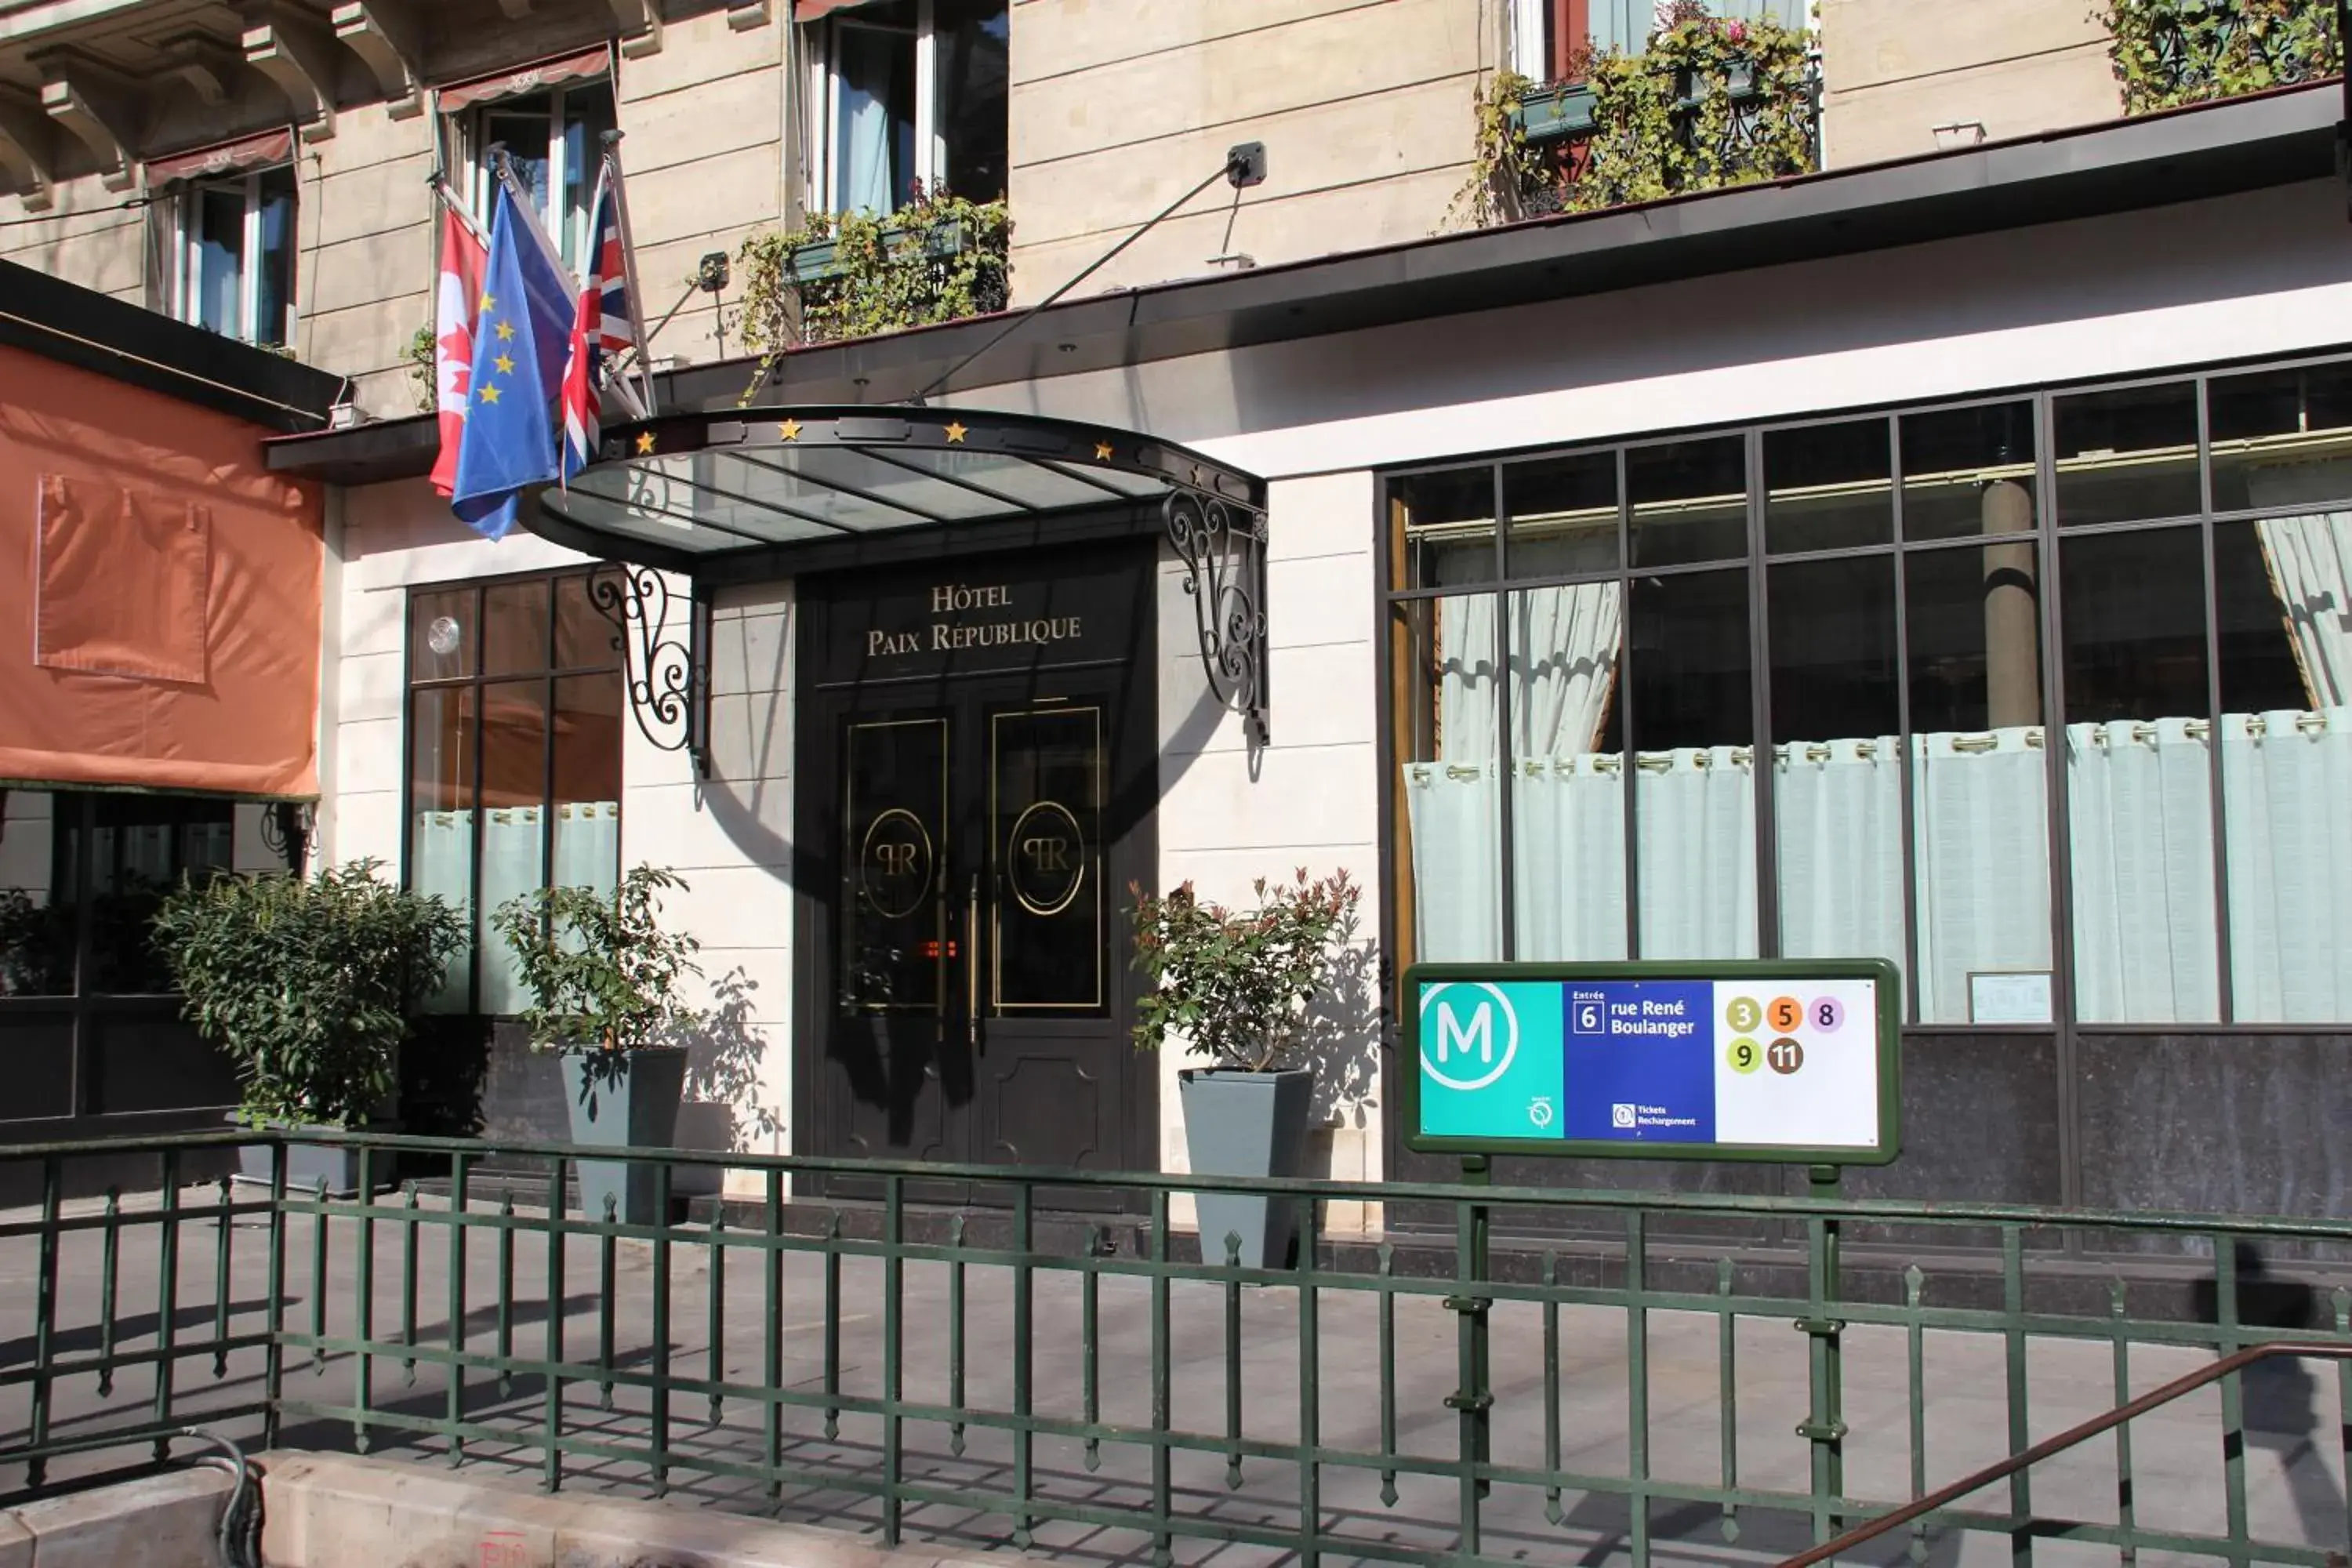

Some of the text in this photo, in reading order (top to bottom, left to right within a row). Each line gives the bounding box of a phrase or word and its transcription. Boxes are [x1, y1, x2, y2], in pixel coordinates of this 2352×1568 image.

[1573, 990, 1605, 1000] Entrée
[1581, 1006, 1597, 1028] 6
[1611, 999, 1684, 1015] rue René
[1736, 1004, 1834, 1026] 3 5 8
[1437, 1001, 1492, 1063] M
[1611, 1019, 1694, 1038] Boulanger
[1737, 1045, 1796, 1067] 9 11
[1638, 1105, 1666, 1114] Tickets
